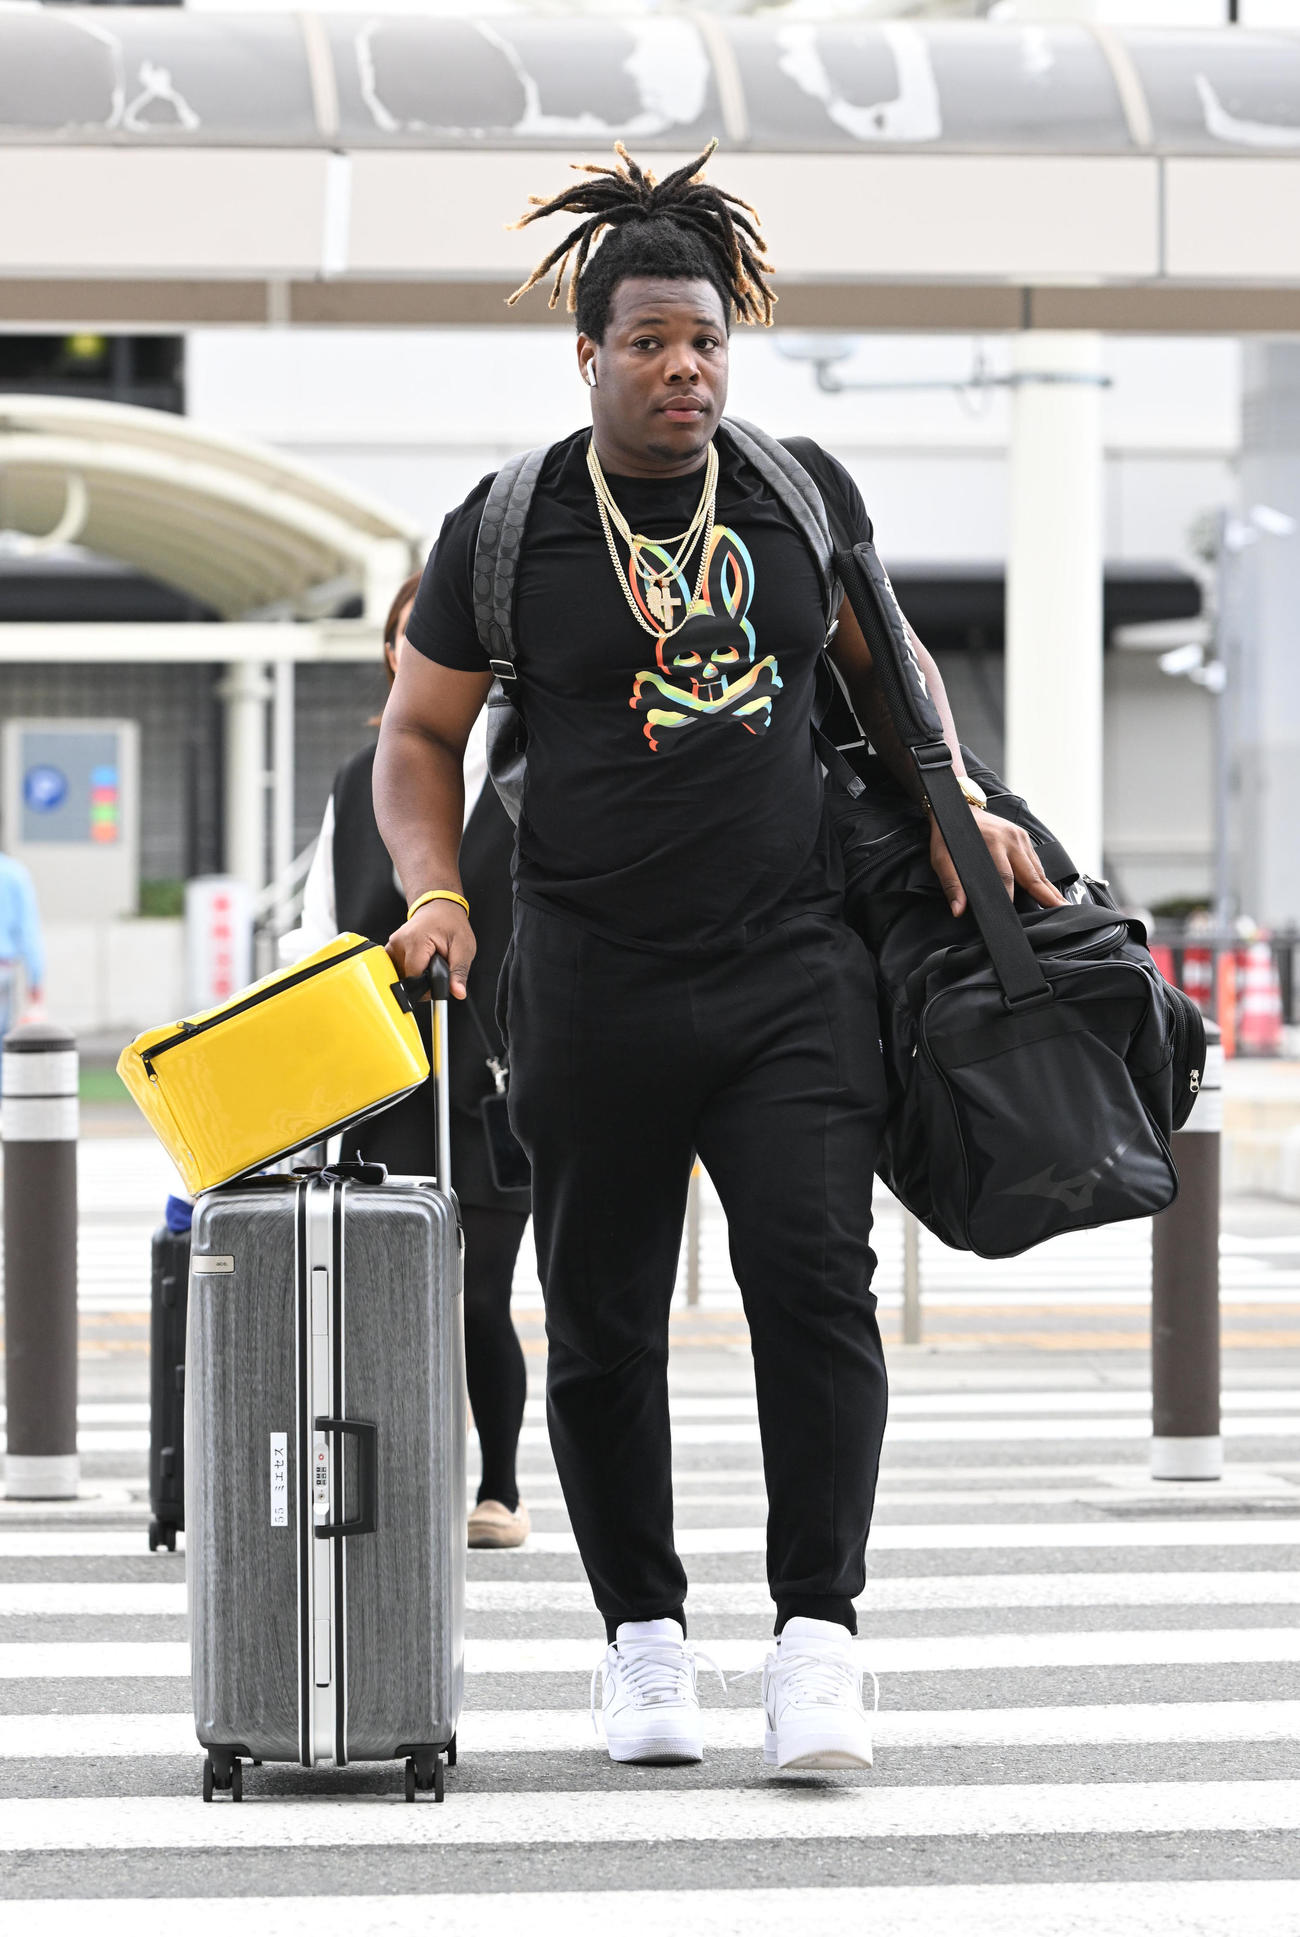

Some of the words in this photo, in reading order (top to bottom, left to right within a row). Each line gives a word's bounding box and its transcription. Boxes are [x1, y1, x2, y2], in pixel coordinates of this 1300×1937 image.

[274, 1447, 285, 1492] ミエセス
[274, 1507, 285, 1524] 55
